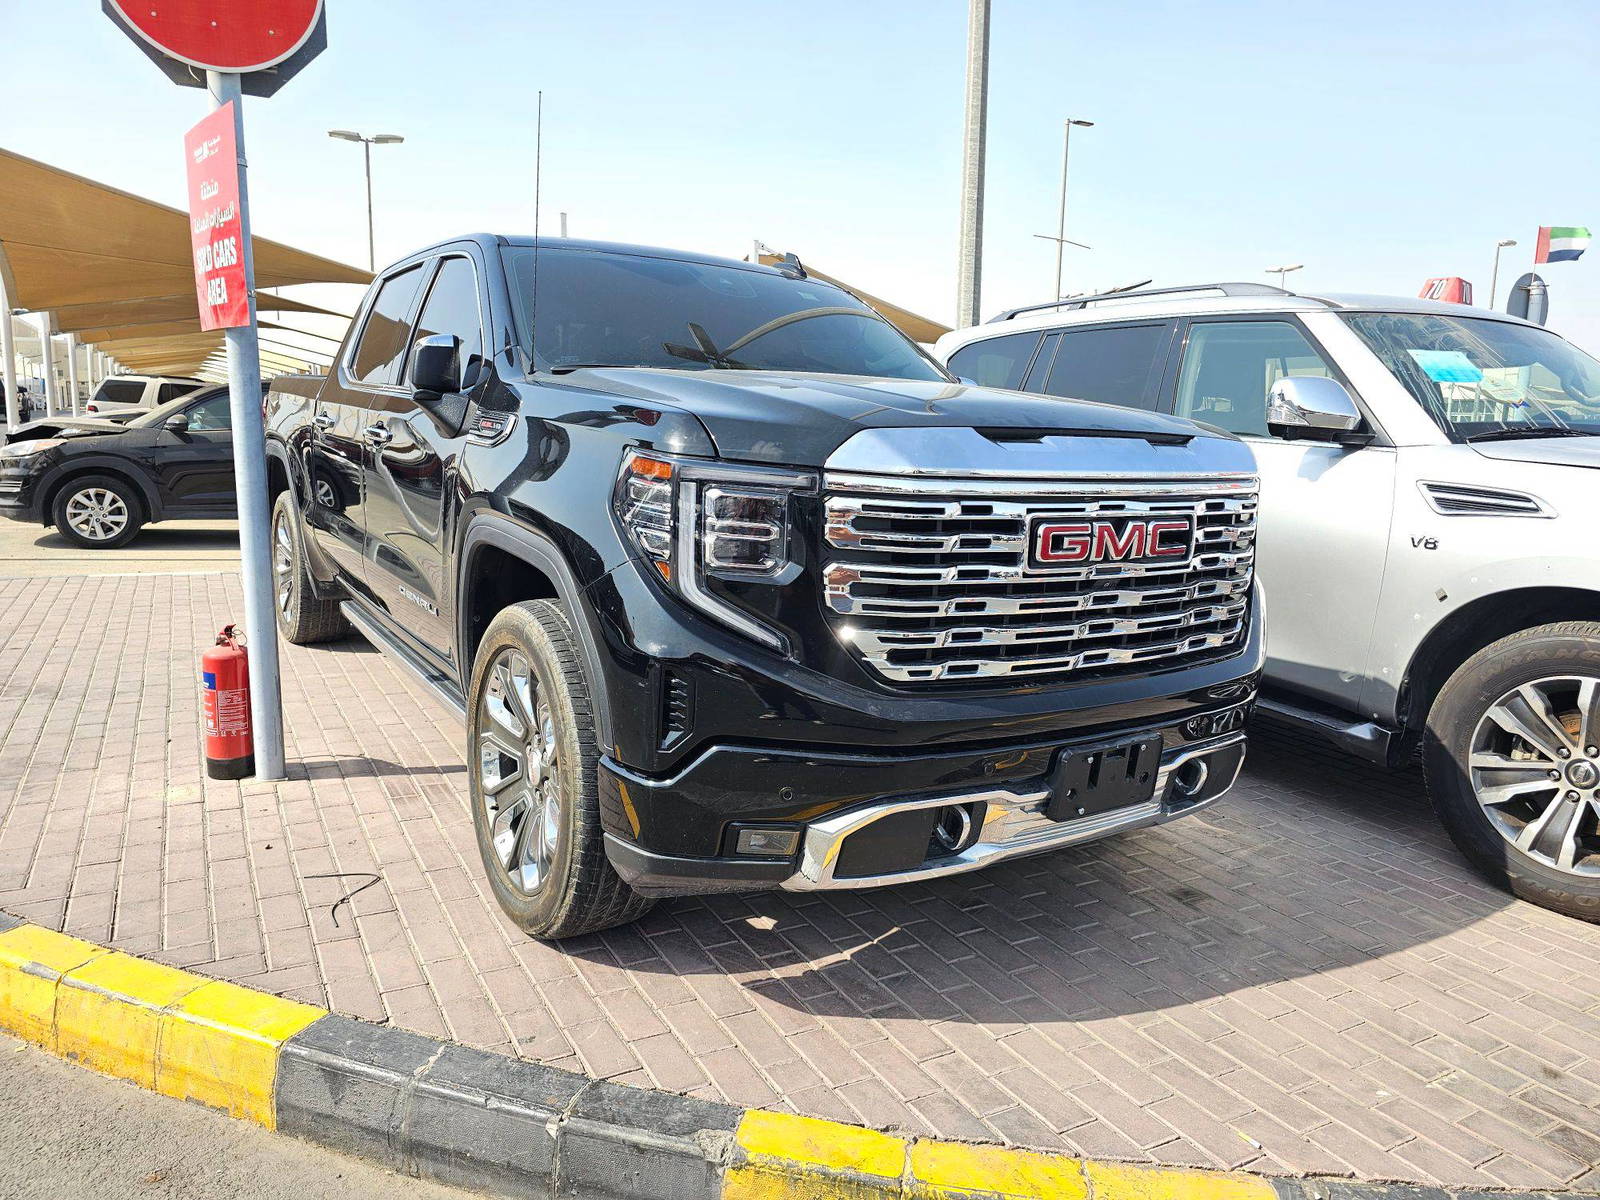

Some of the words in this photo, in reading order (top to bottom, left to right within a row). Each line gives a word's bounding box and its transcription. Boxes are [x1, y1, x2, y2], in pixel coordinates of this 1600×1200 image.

[213, 236, 238, 269] CARS
[208, 277, 228, 306] AREA
[1424, 279, 1448, 301] 70
[1035, 520, 1190, 563] GMC
[1410, 535, 1440, 550] V8
